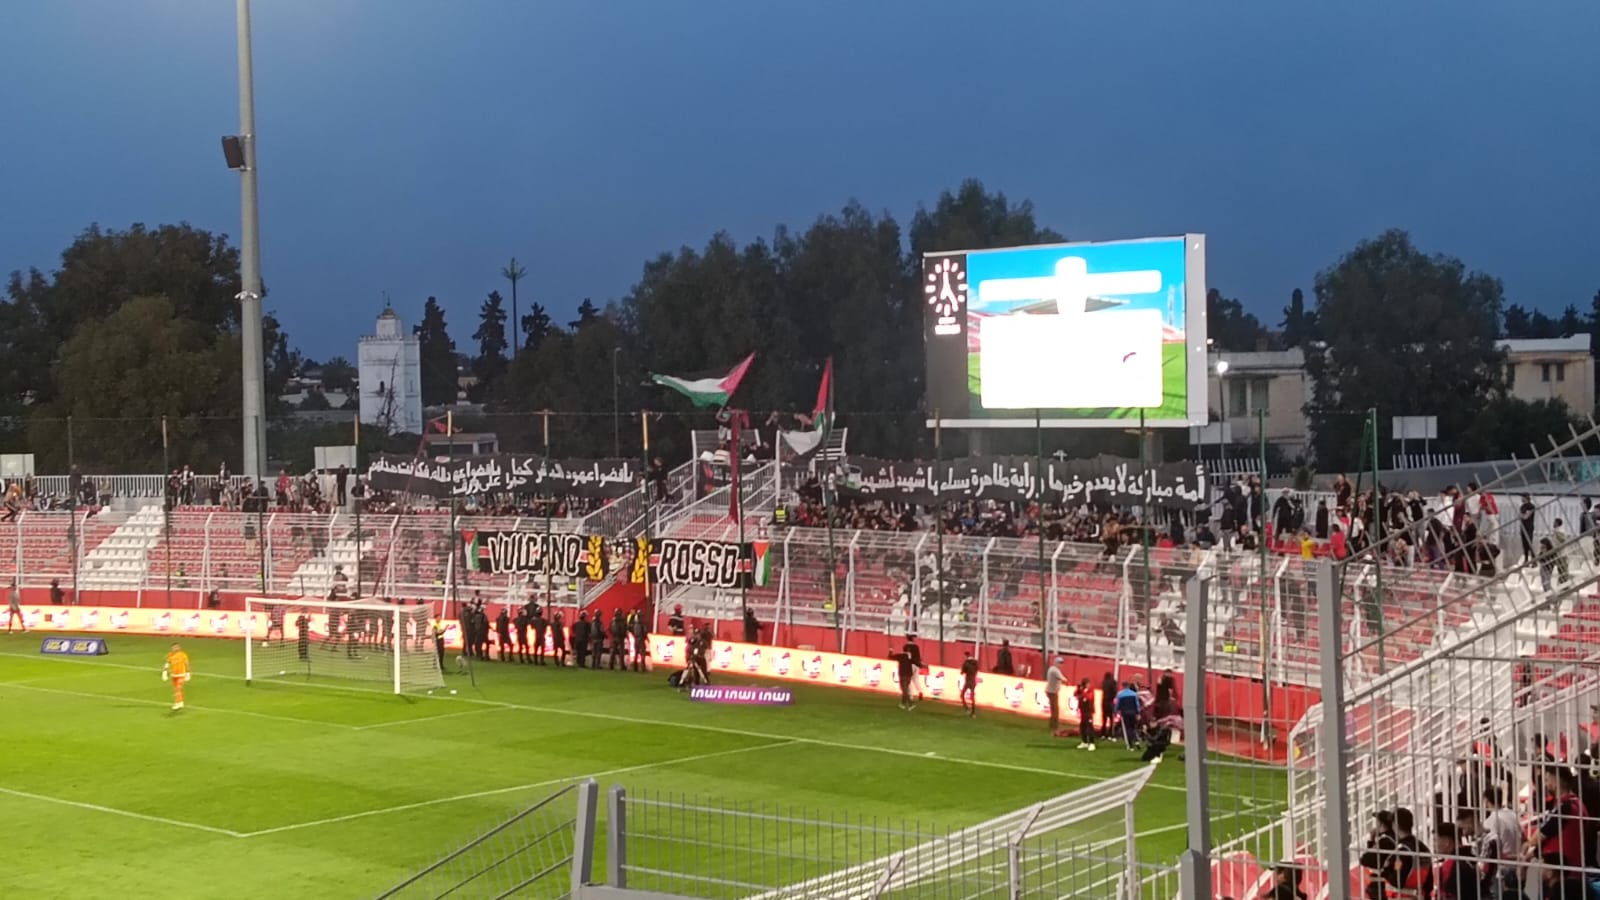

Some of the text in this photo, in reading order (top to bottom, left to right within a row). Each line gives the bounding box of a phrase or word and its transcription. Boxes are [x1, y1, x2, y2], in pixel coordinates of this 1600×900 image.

[511, 457, 533, 475] كما
[896, 467, 926, 493] شهيد
[972, 462, 1010, 497] طاهرة
[1176, 464, 1206, 502] أمة
[488, 532, 739, 587] VULCANO ROSSO
